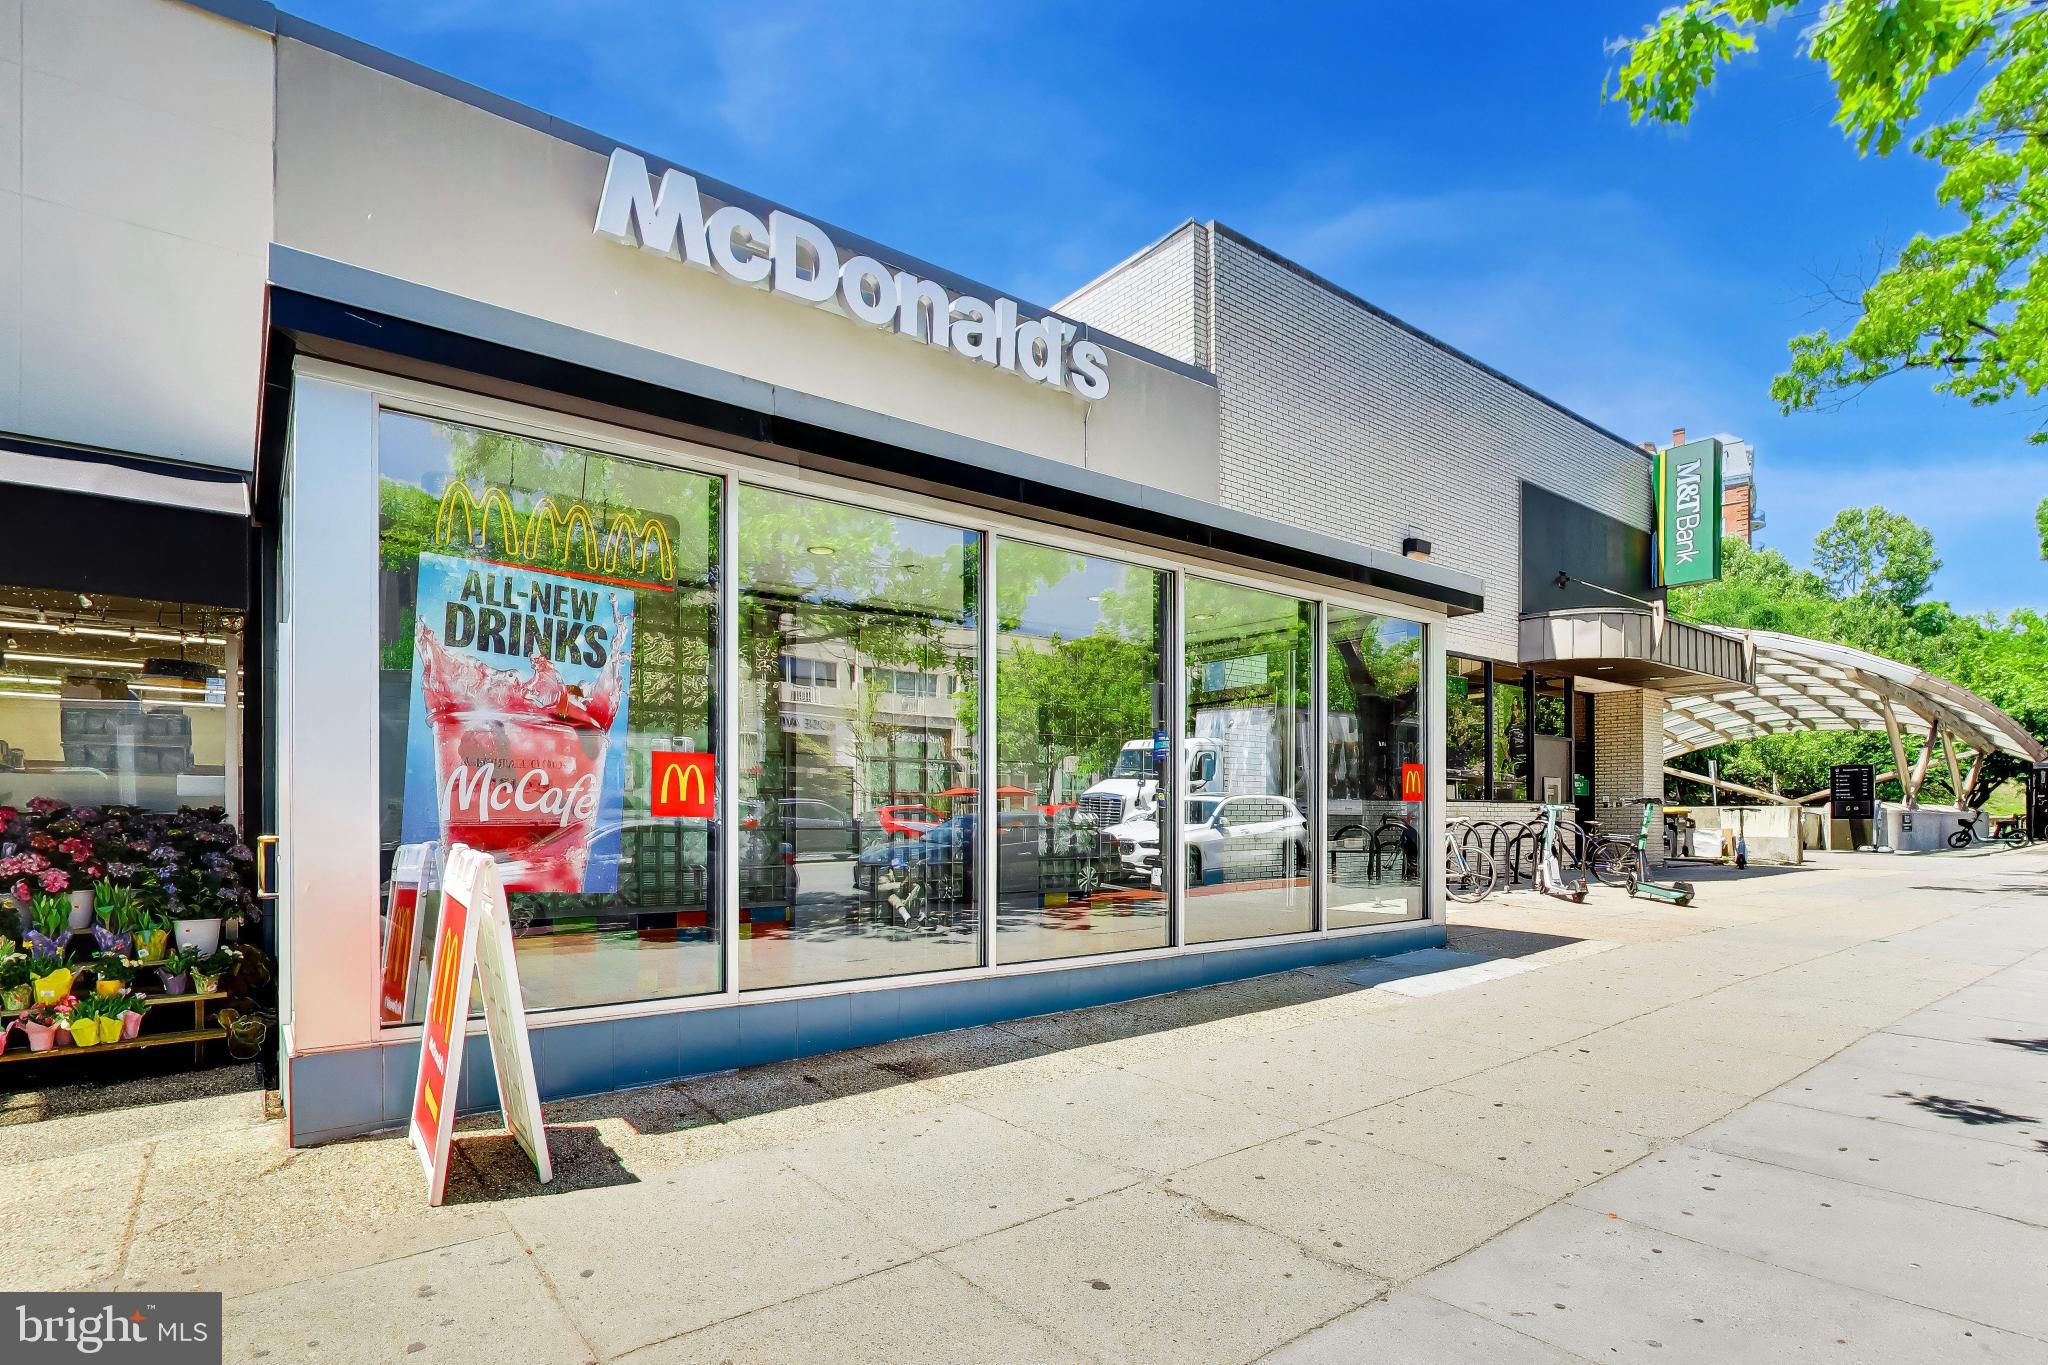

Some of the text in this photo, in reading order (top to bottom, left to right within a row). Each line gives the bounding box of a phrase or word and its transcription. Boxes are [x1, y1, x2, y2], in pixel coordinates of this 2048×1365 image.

[593, 146, 1110, 399] McDonald's
[1676, 458, 1701, 565] M&T Bank
[445, 602, 608, 668] DRINKS
[461, 569, 599, 622] ALL-NEW
